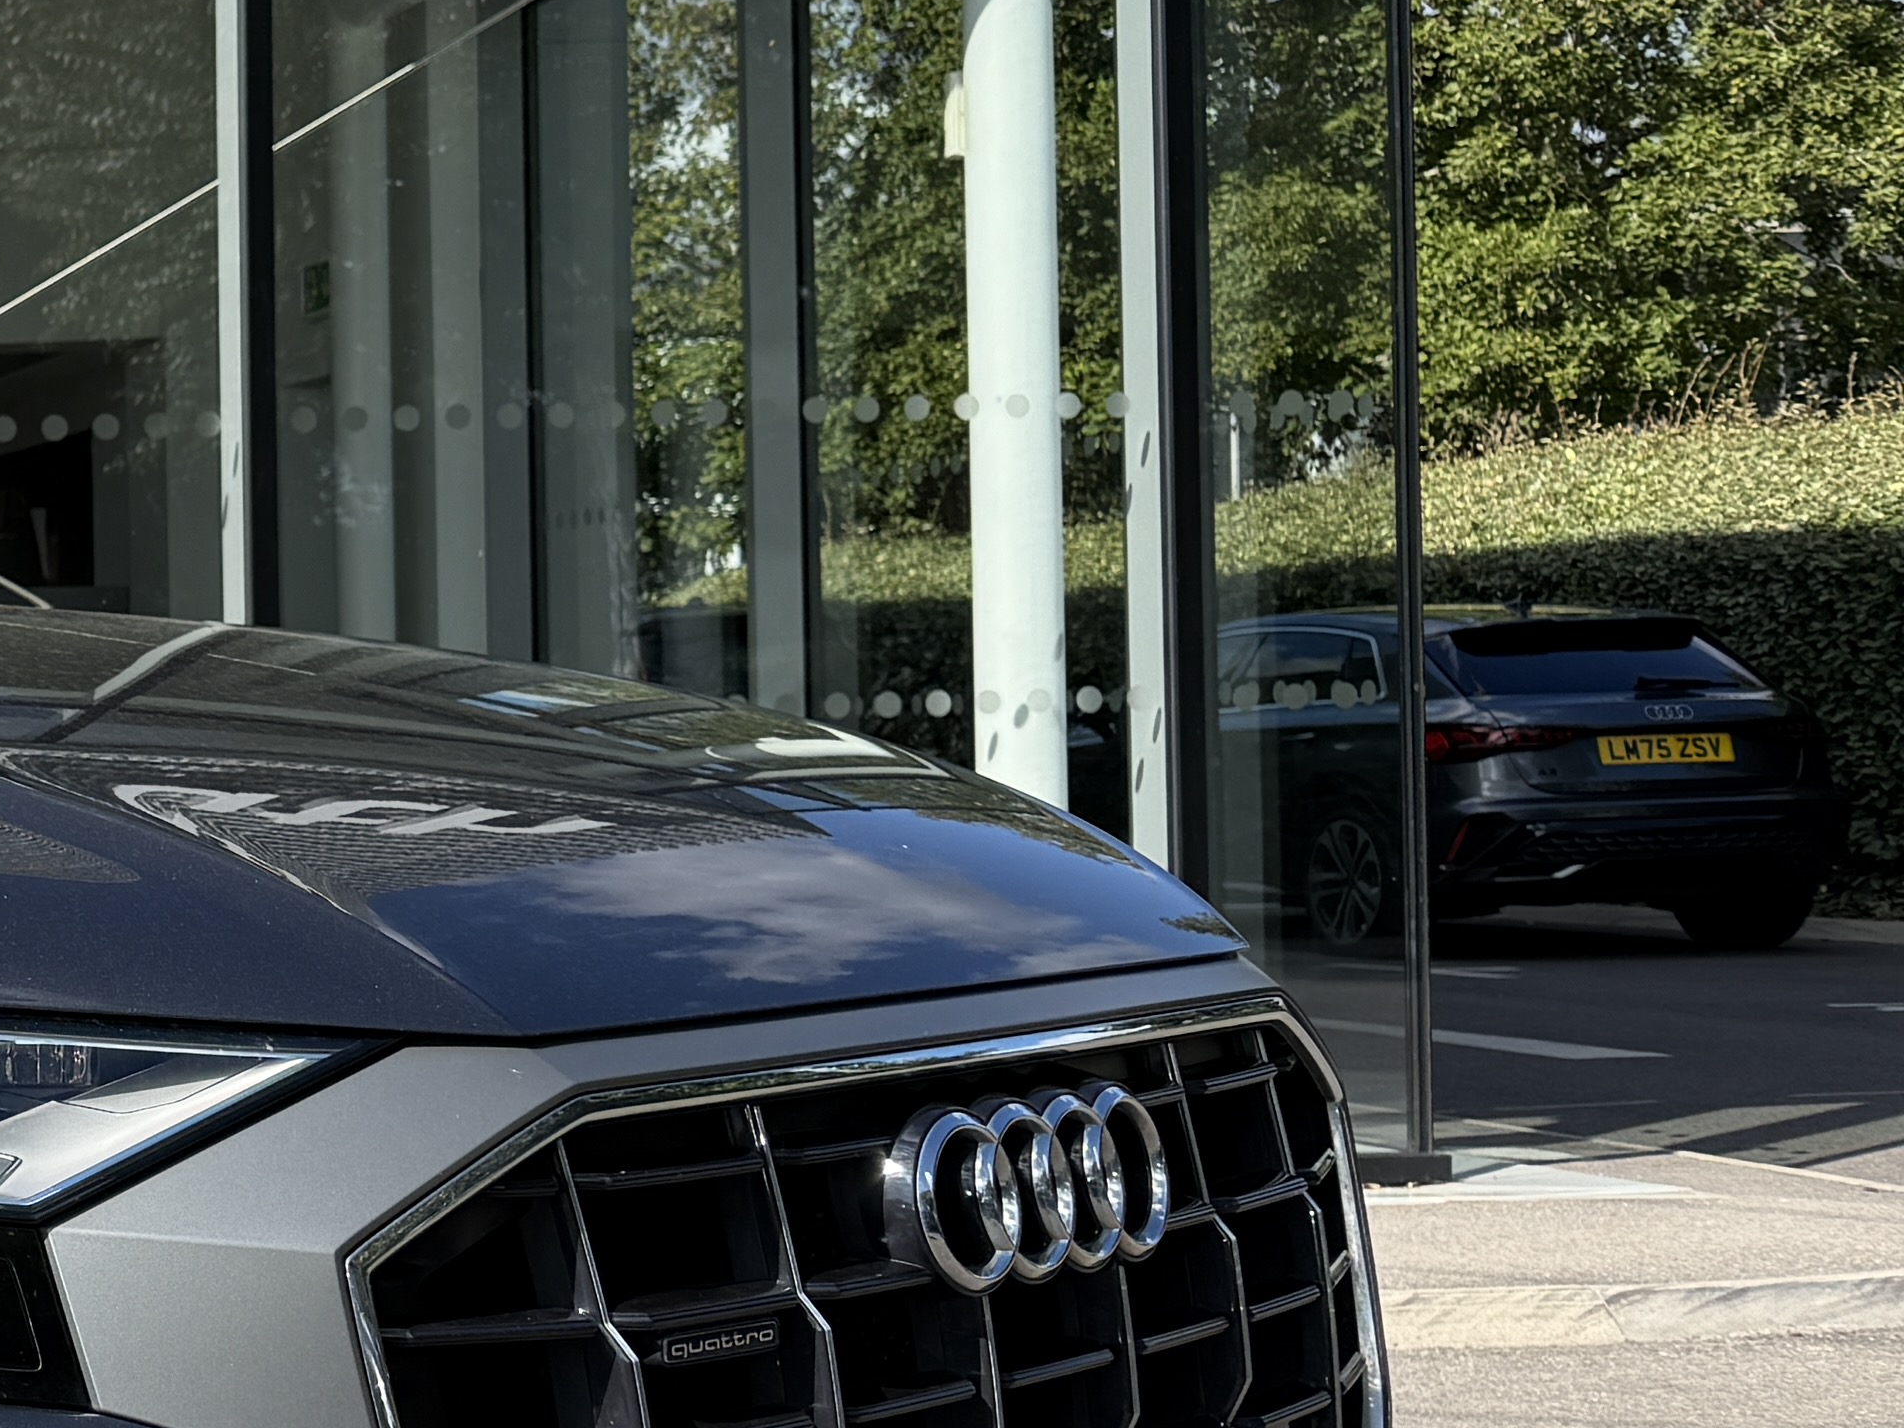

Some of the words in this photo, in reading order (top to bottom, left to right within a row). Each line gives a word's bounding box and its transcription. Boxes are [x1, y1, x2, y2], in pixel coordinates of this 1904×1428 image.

[1608, 737, 1671, 761] LM75
[1677, 736, 1721, 759] ZSV
[672, 1329, 774, 1358] quattro
